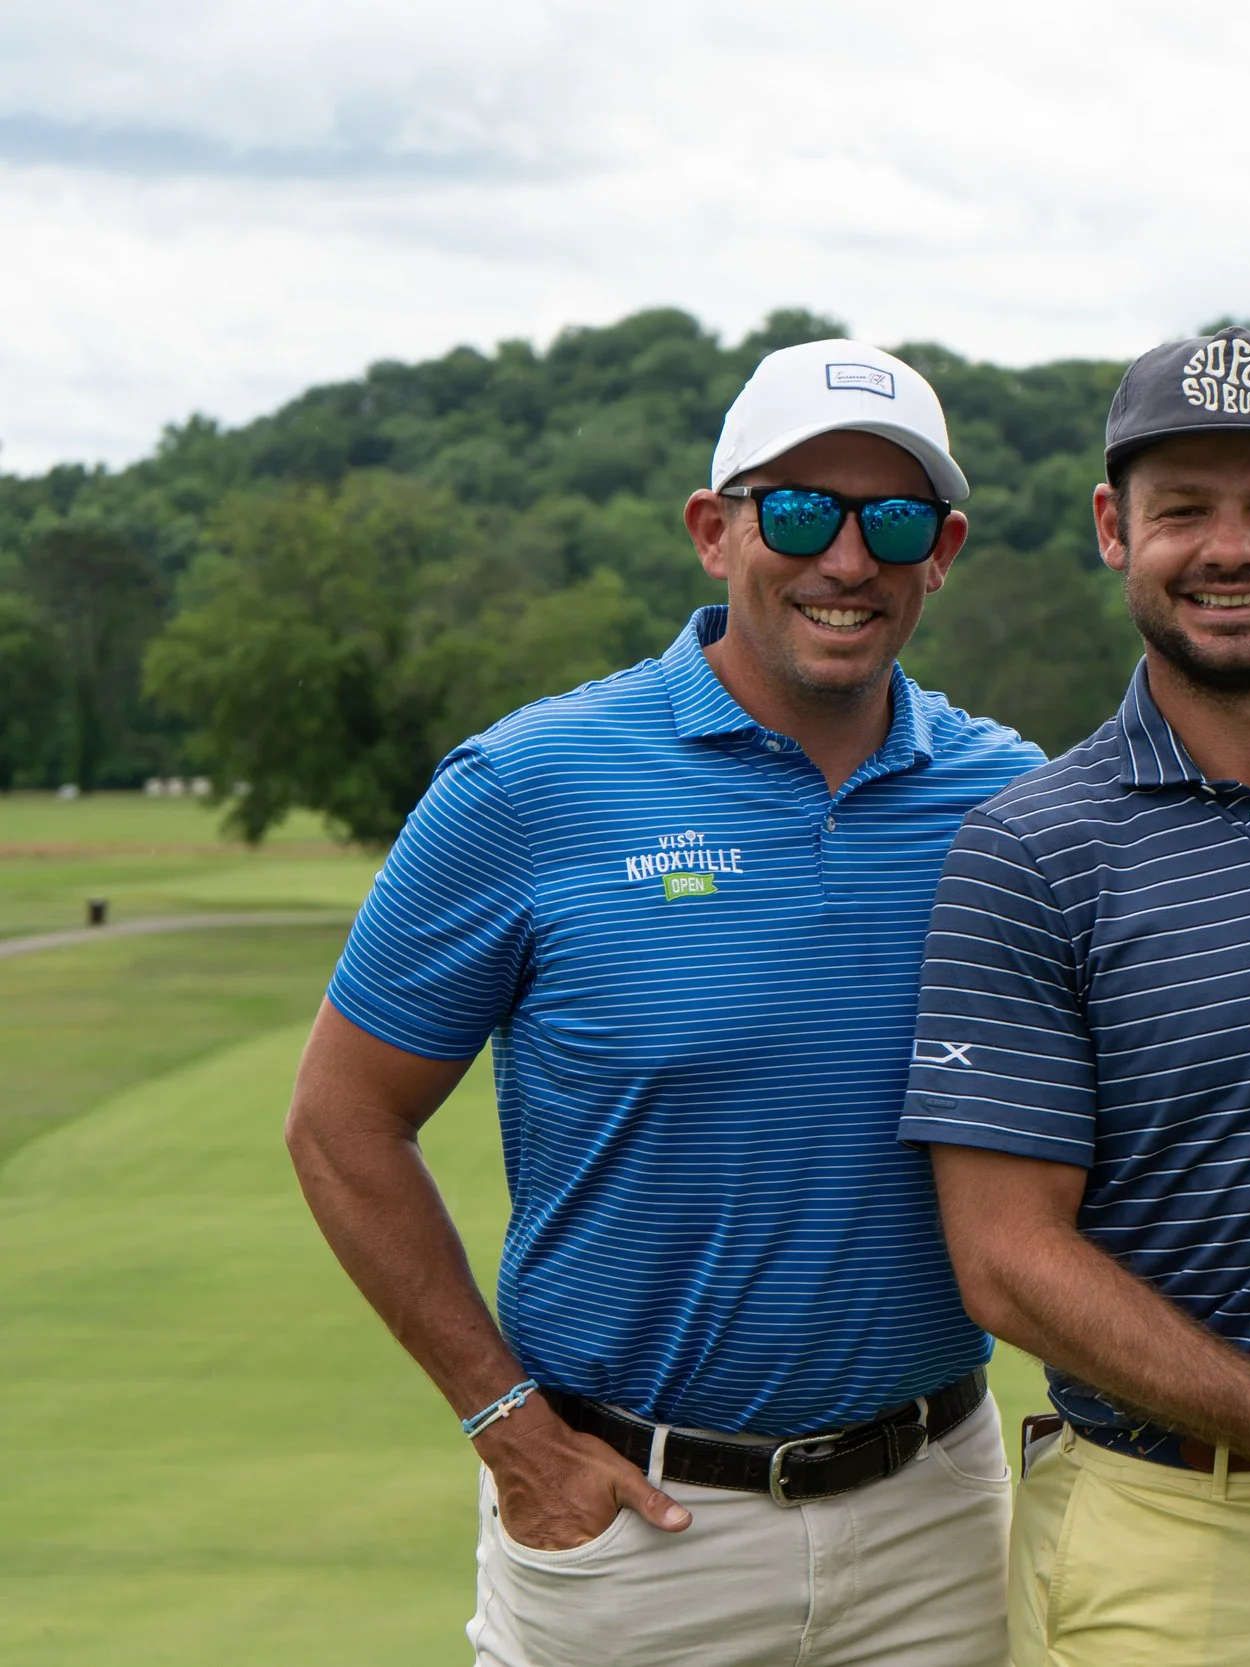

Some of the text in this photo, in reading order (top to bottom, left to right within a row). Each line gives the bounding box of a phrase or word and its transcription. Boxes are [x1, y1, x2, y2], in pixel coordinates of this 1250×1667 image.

[1183, 339, 1227, 378] SO
[1182, 377, 1218, 412] SO
[658, 830, 705, 850] VISIT
[625, 848, 744, 881] KNOXVILLE
[671, 877, 705, 893] OPEN
